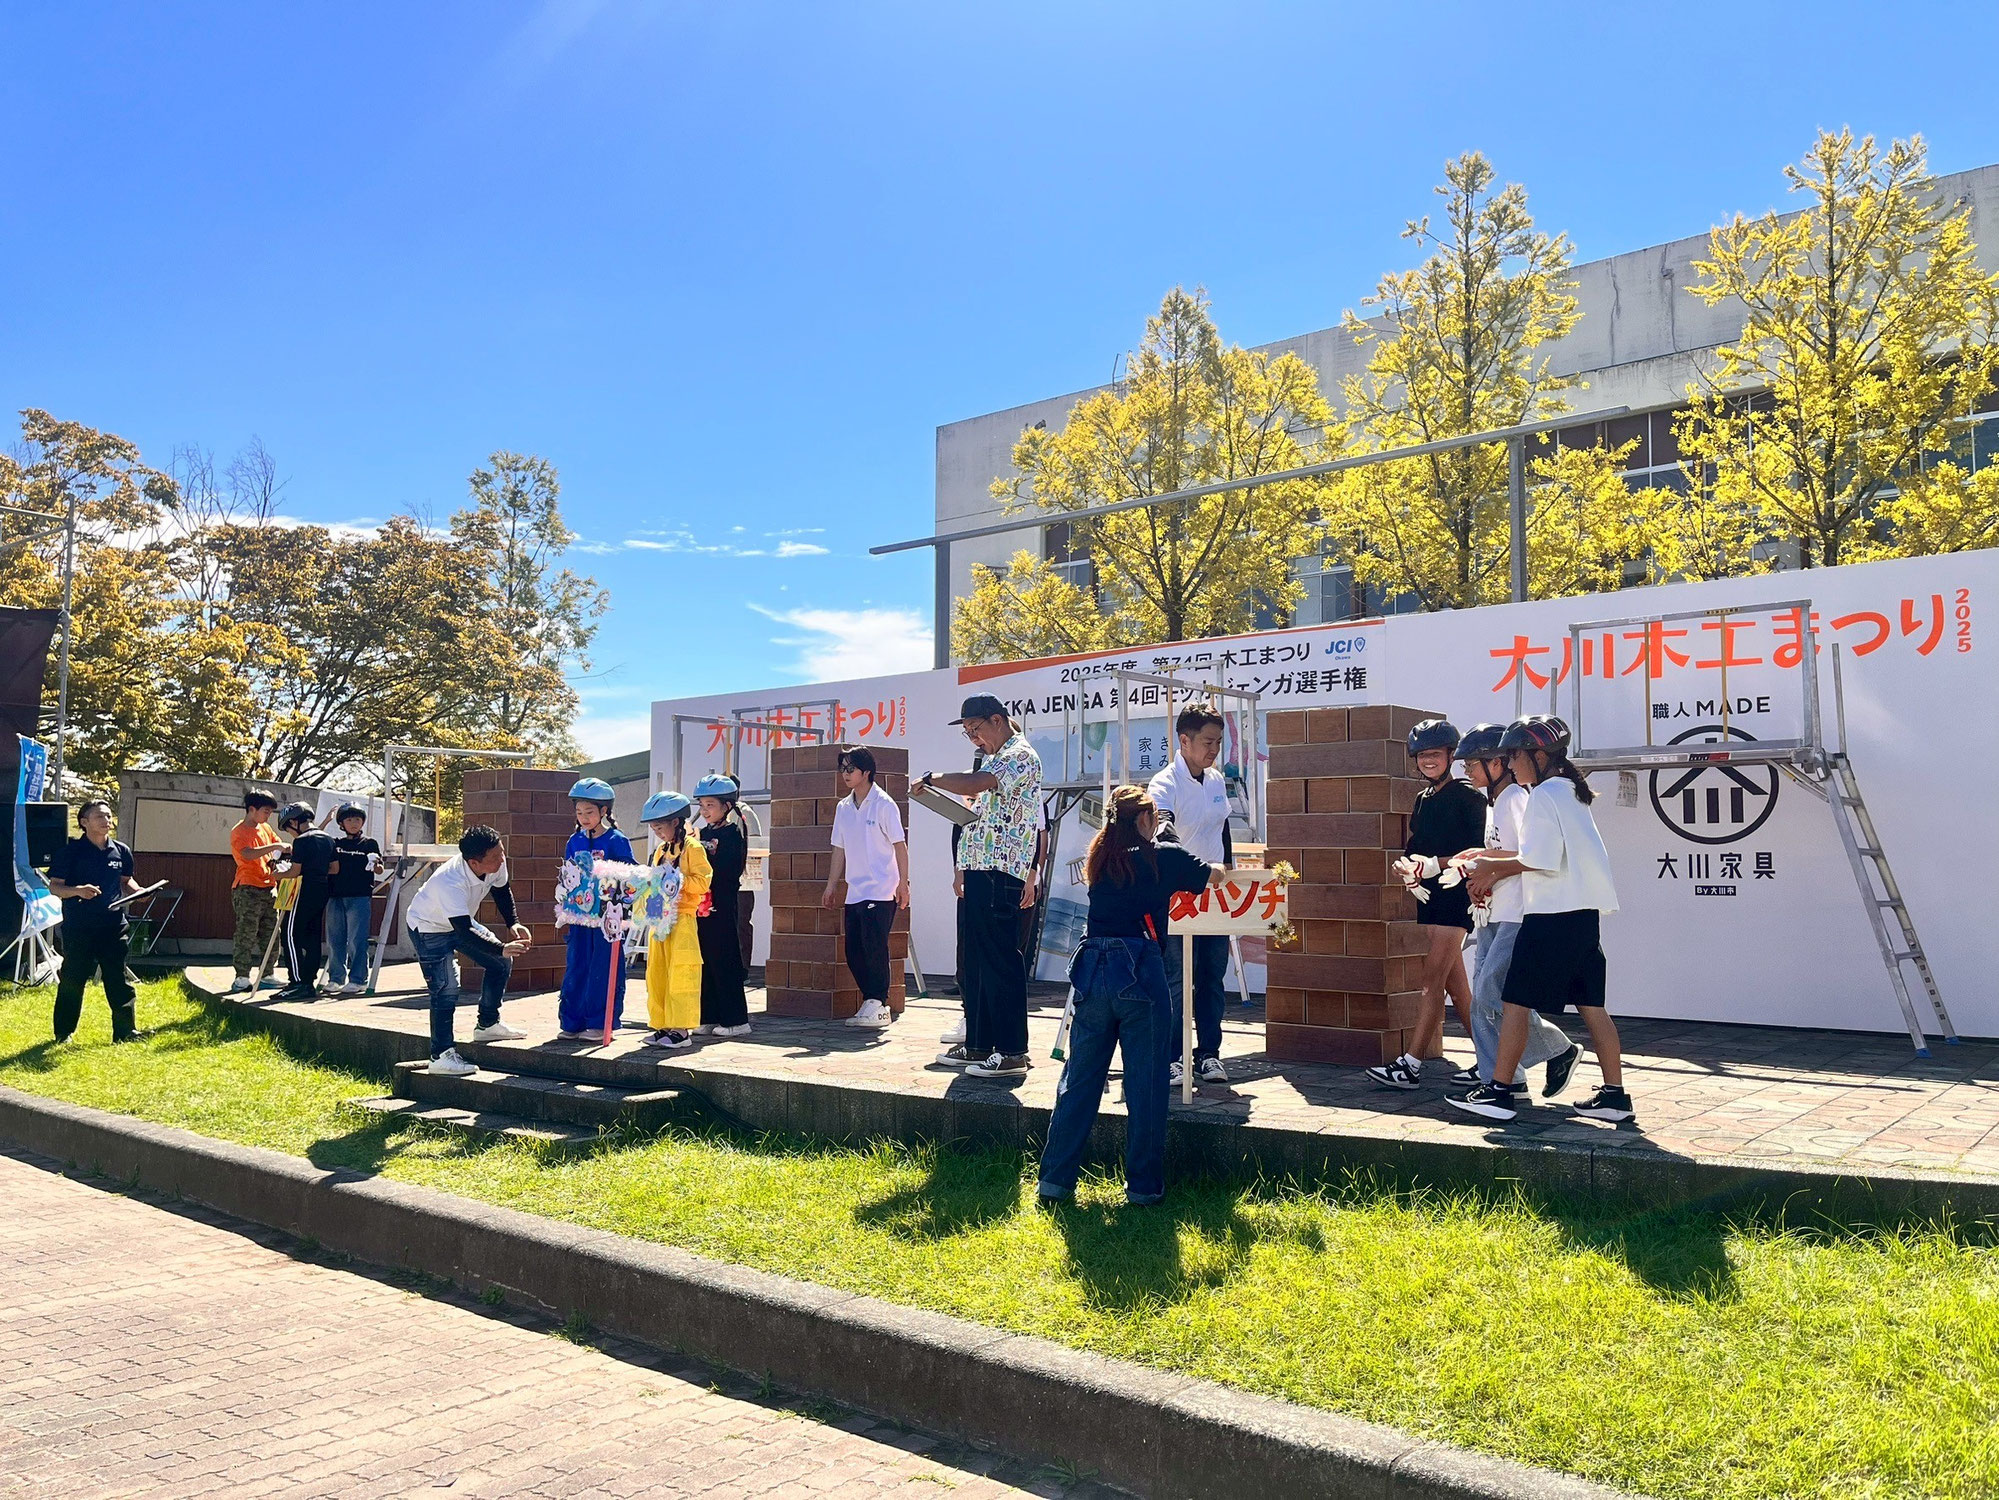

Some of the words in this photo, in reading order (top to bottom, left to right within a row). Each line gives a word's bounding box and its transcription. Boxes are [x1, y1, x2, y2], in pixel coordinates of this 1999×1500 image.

[1955, 588, 1972, 652] 2025
[1220, 643, 1311, 668] 木工まつり
[1325, 640, 1352, 654] JCI
[1489, 594, 1944, 692] 大川木工まつり
[1042, 692, 1104, 714] JENGA
[707, 700, 895, 753] 大川木工まつり
[1138, 737, 1152, 770] 家具
[1657, 852, 1775, 879] 大川家具
